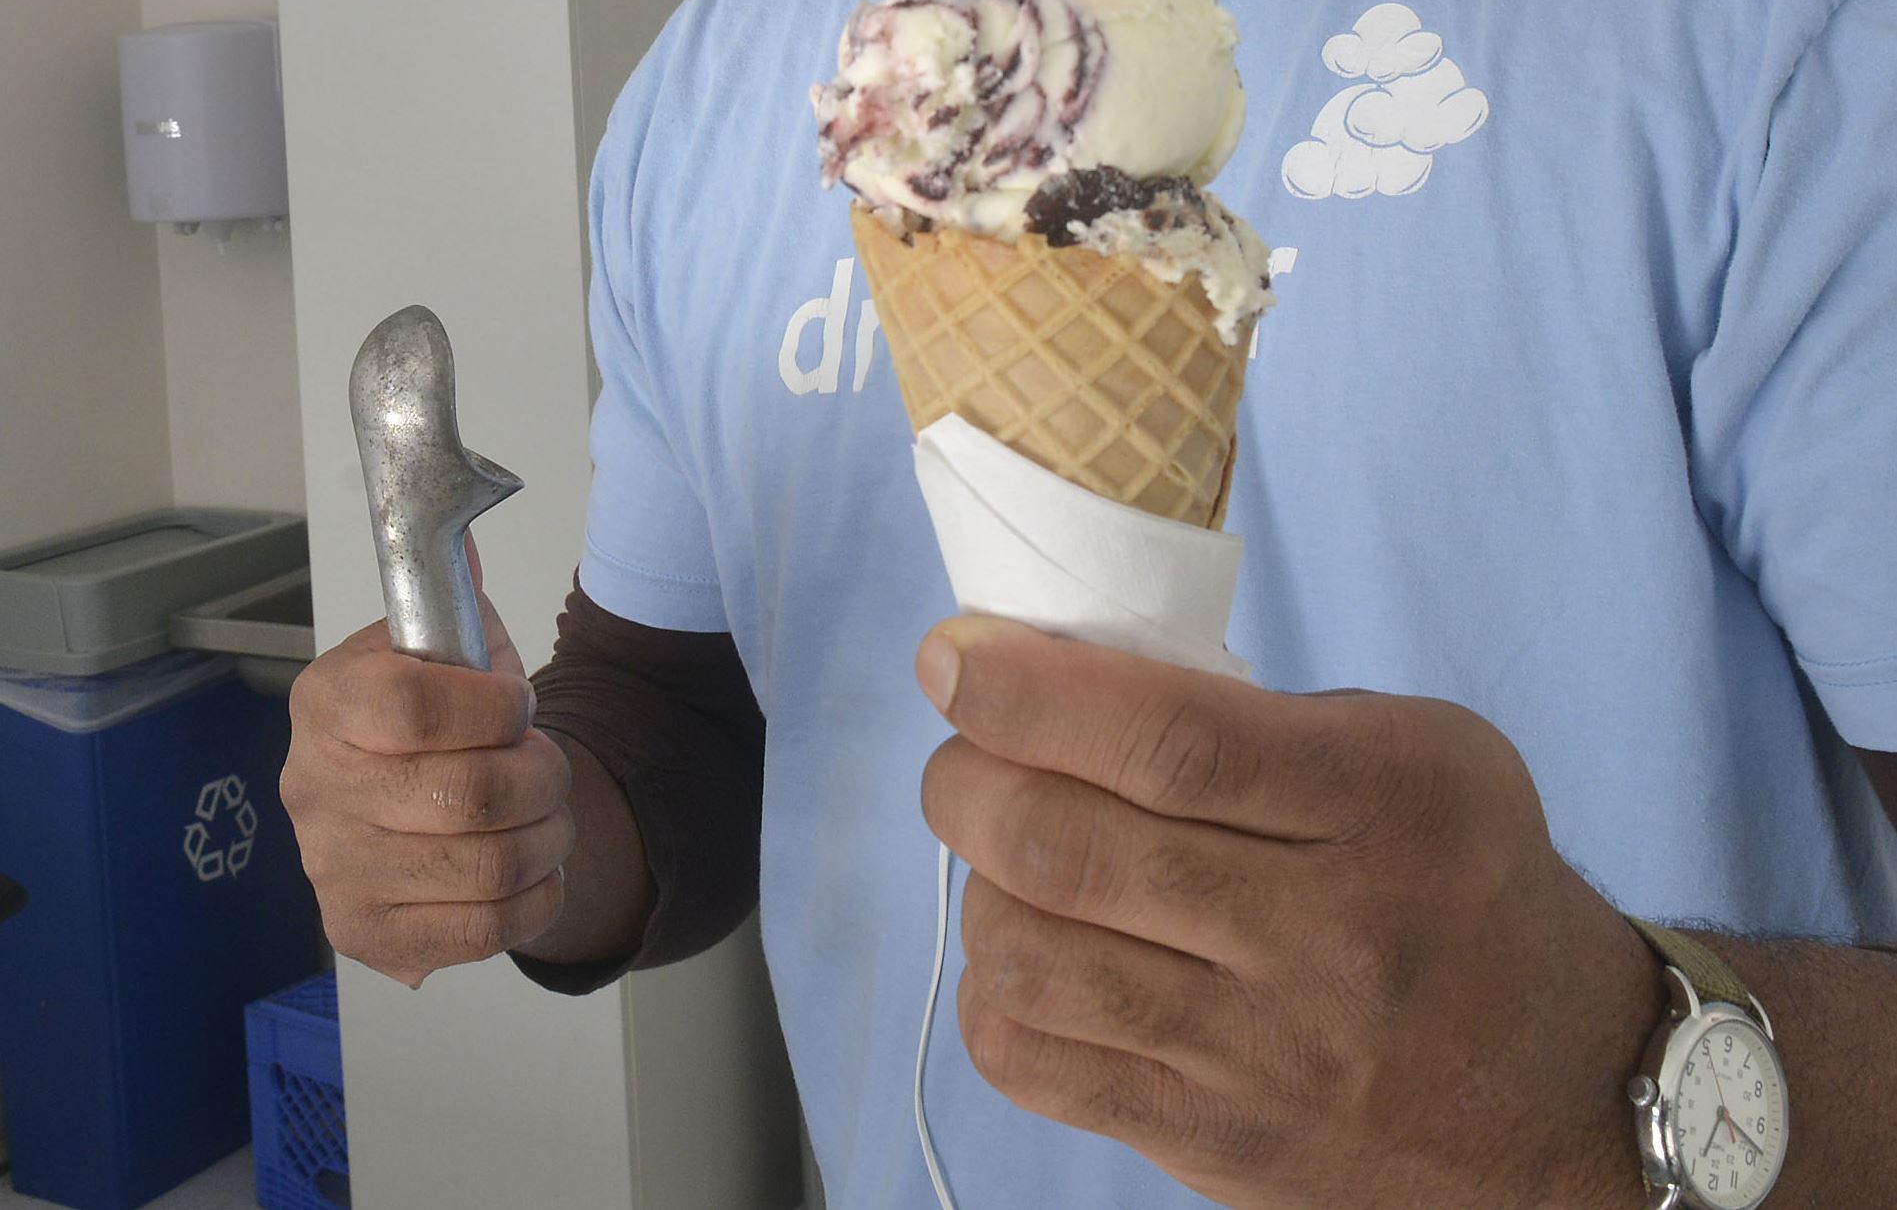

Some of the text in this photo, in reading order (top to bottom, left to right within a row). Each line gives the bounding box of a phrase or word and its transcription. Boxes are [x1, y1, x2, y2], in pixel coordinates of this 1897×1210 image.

[1724, 1035, 1733, 1053] 6
[1743, 1051, 1752, 1070] 7
[1754, 1080, 1763, 1098] 8
[1756, 1116, 1765, 1134] 9
[1691, 1157, 1696, 1175] 1
[1745, 1149, 1757, 1167] 10
[1707, 1173, 1719, 1192] 12
[1730, 1169, 1739, 1189] 11
